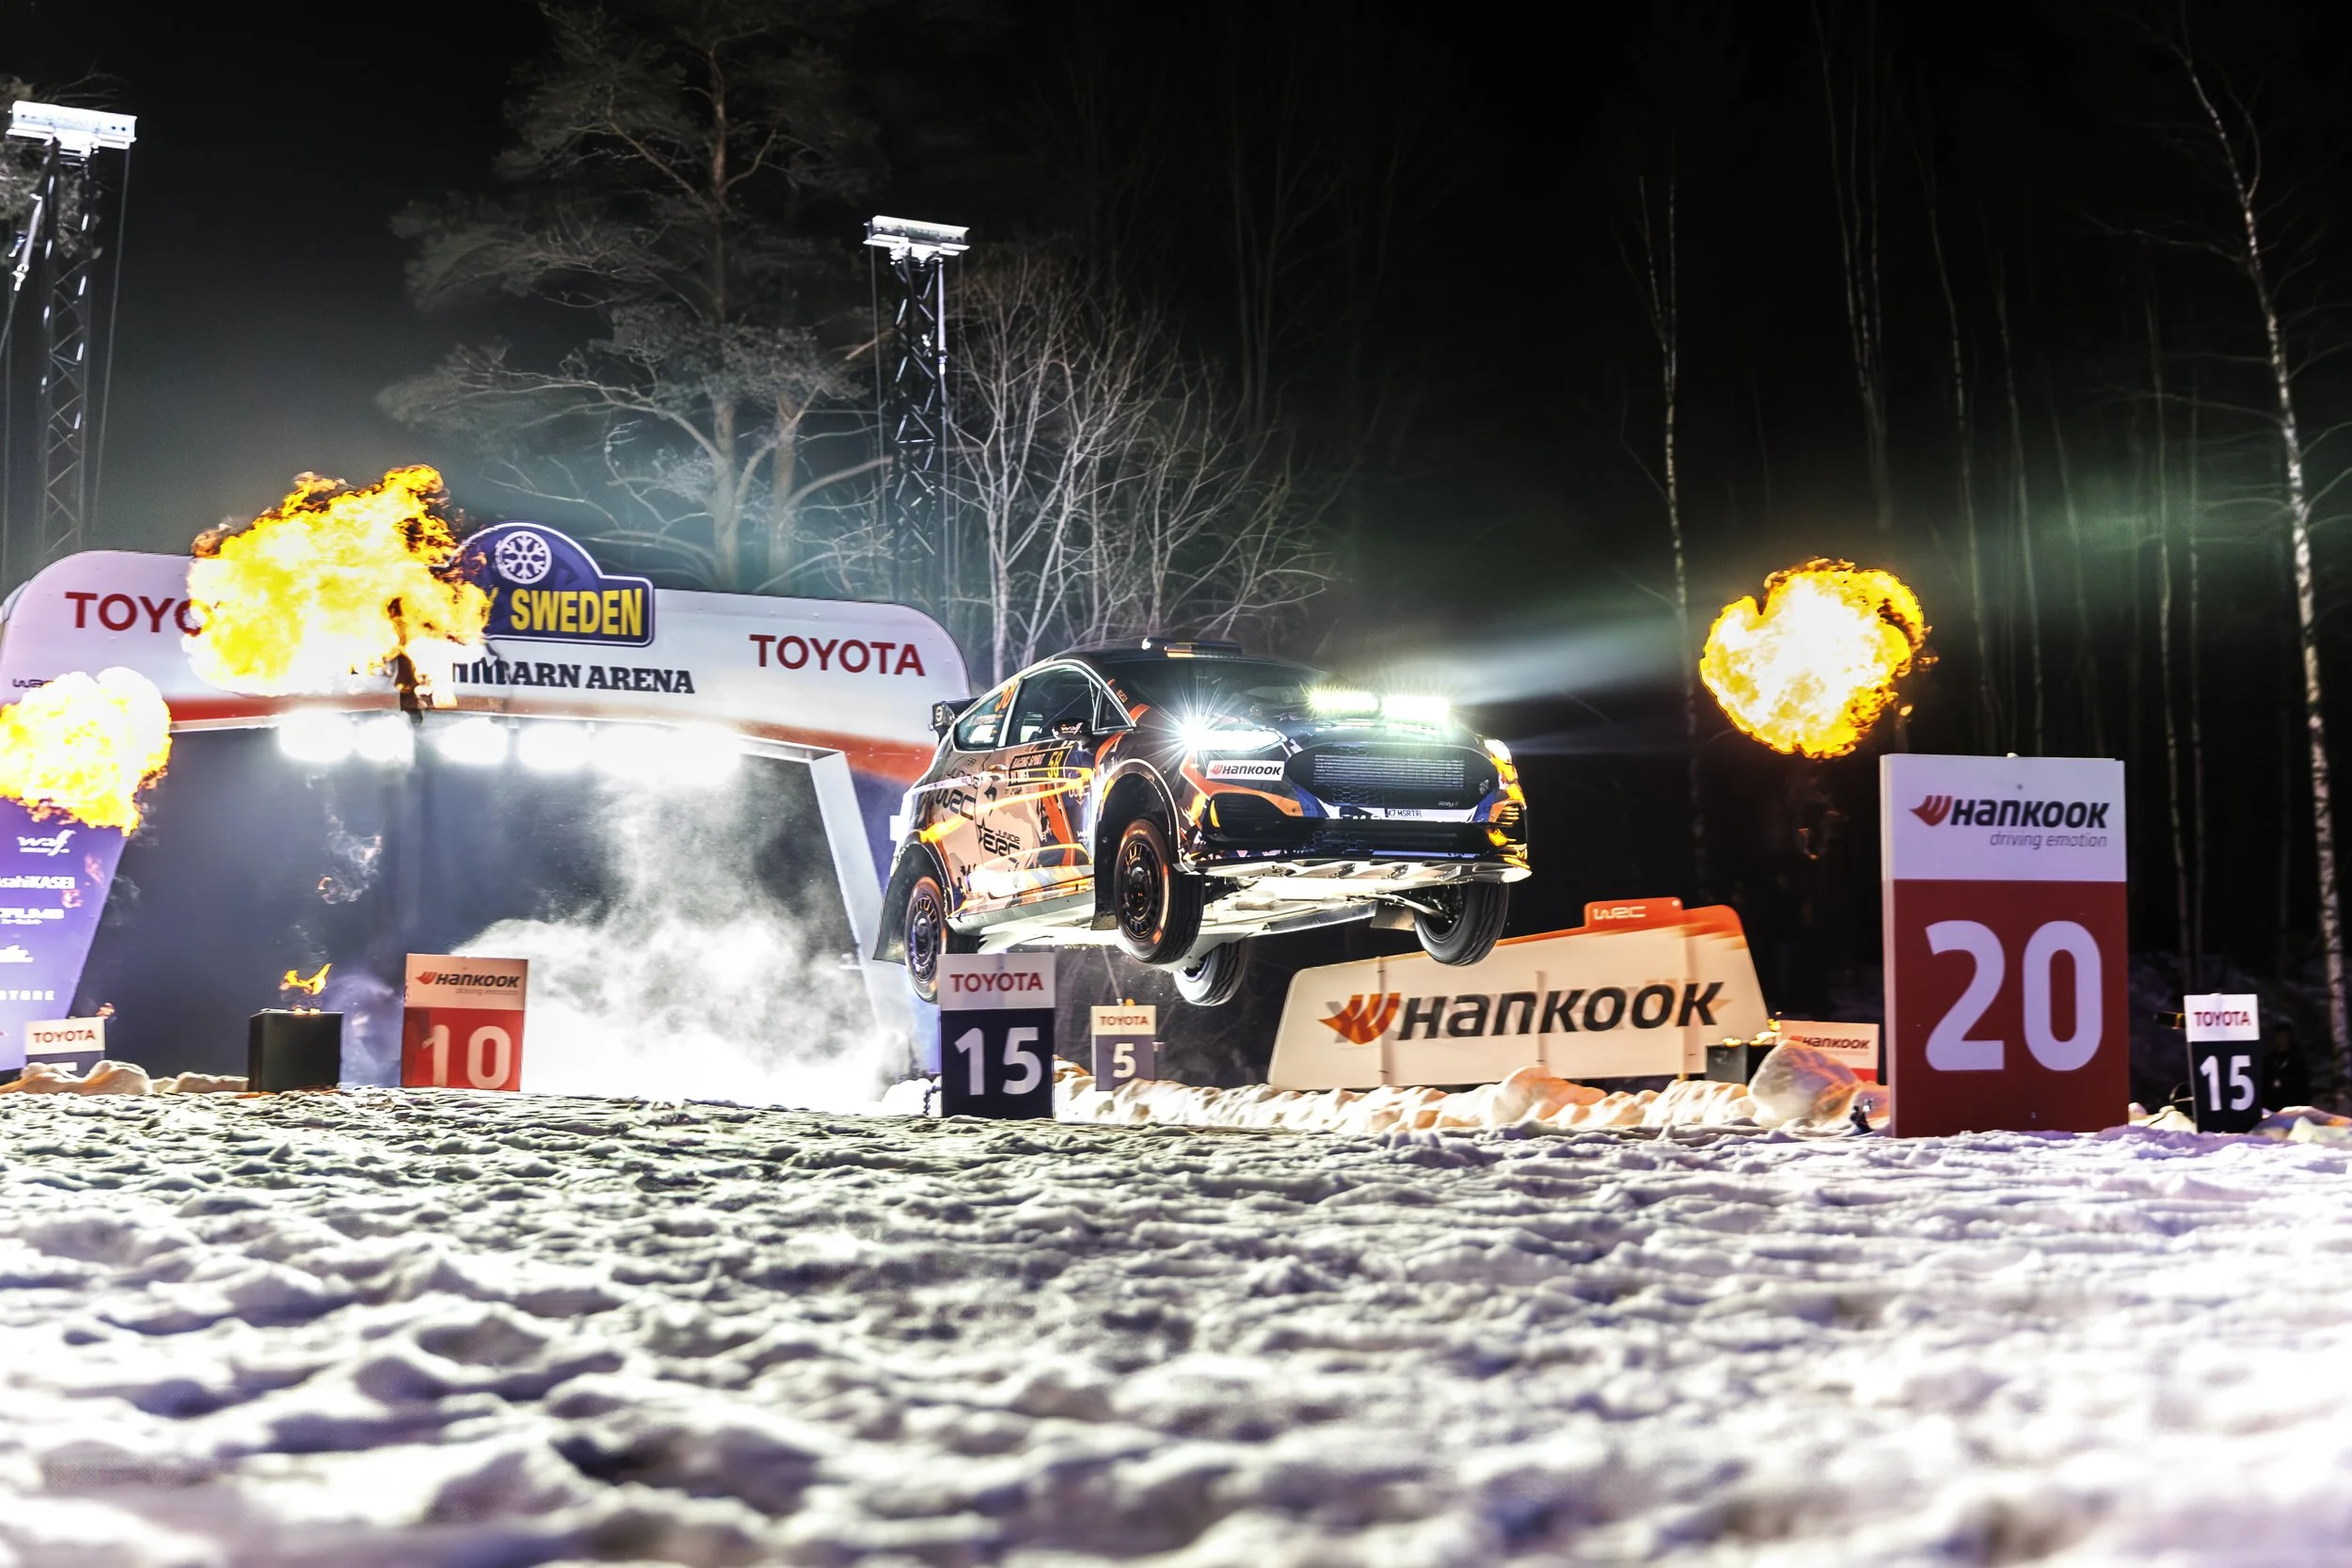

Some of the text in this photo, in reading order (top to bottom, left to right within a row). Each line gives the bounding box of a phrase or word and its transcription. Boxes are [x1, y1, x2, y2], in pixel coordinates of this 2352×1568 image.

[64, 592, 202, 638] TOYO
[511, 588, 643, 637] SWEDEN
[749, 634, 926, 677] TOYOTA
[585, 665, 695, 694] ARENA
[1990, 832, 2107, 849] driving emotion
[950, 972, 1044, 992] TOYOTA
[1925, 920, 2103, 1071] 20
[33, 1029, 97, 1043] TOYOTA
[1099, 1015, 1150, 1026] TOYOTA
[2193, 1011, 2251, 1027] TOYOTA
[421, 1024, 512, 1090] 10
[954, 1026, 1042, 1096] 15
[1112, 1042, 1136, 1079] 5
[2200, 1054, 2255, 1112] 15
